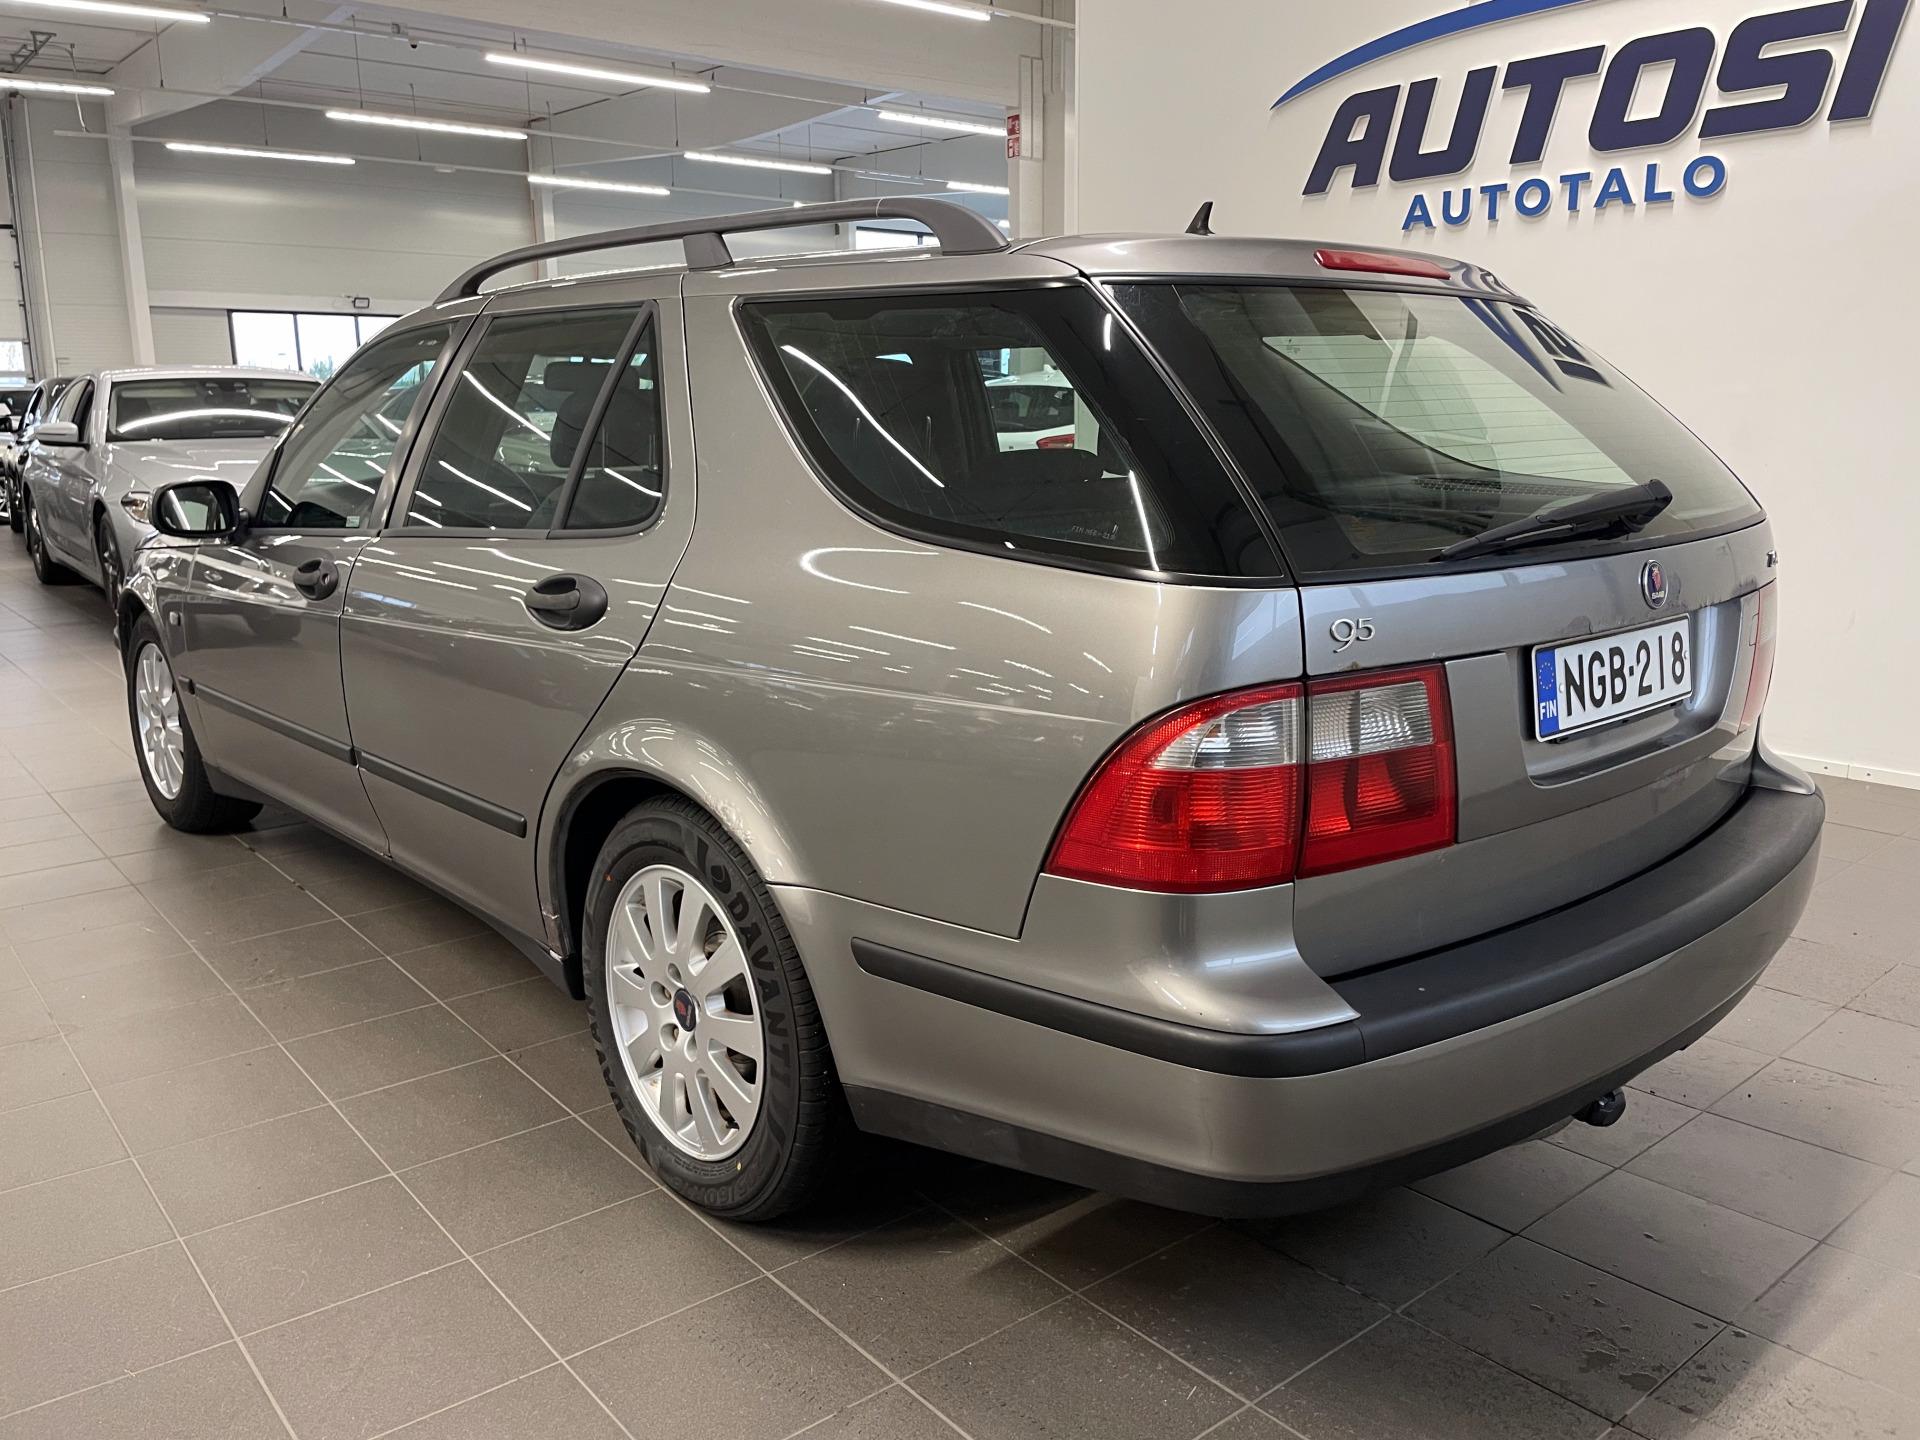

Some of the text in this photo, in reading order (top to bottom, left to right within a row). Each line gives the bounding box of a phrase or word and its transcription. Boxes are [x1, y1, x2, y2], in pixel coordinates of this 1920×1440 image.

[1301, 0, 1908, 196] AUTOSI
[1402, 156, 1728, 231] AUTOTALO
[1330, 617, 1376, 653] 95
[1563, 631, 1686, 717] NGB-218
[1539, 701, 1557, 720] FIN
[727, 891, 790, 1087] DAVANTI
